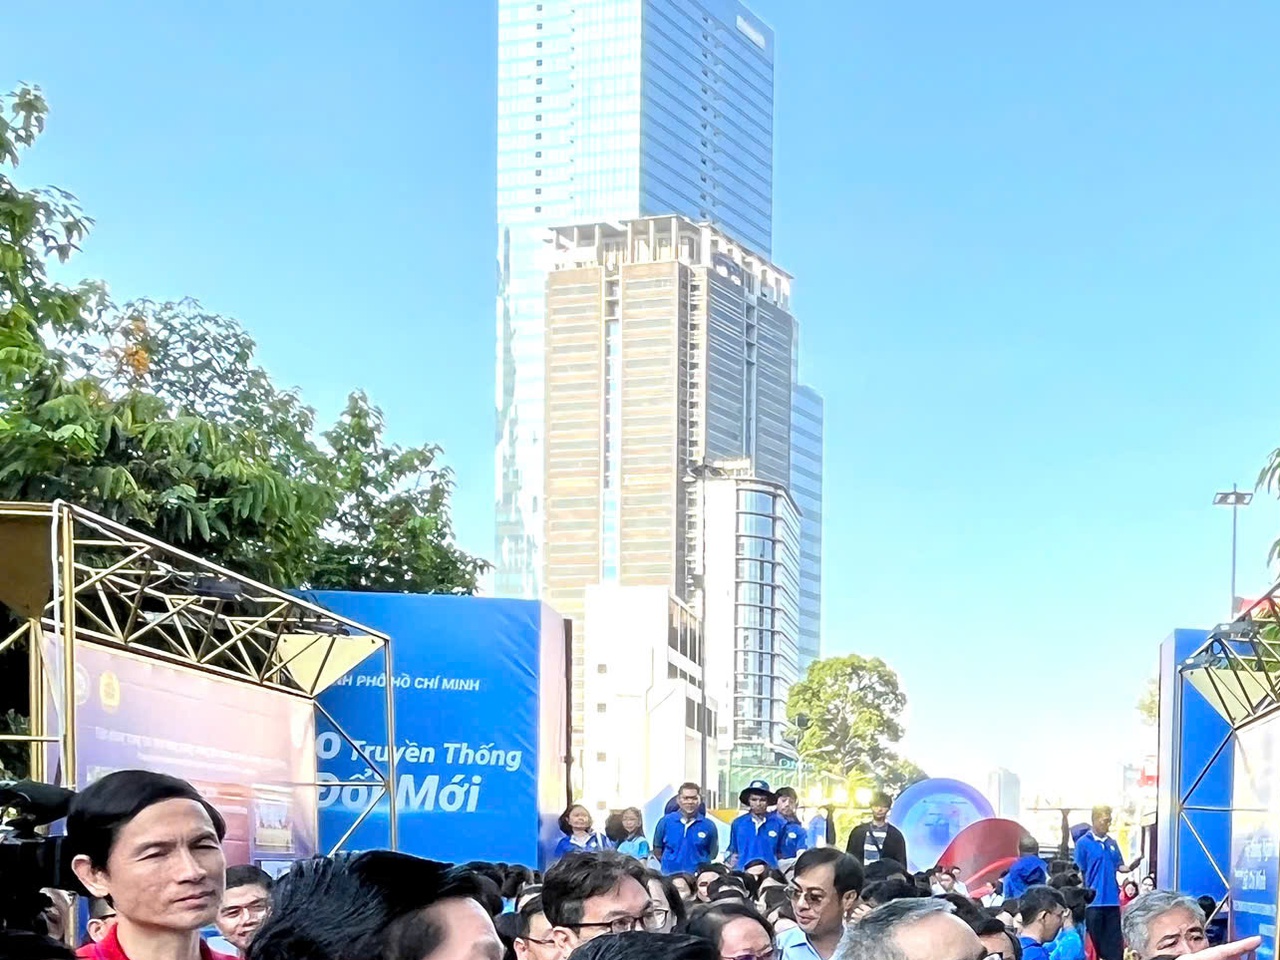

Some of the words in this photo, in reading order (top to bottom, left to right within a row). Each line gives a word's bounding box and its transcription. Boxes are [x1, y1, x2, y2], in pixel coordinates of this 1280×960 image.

[414, 674, 440, 690] CHÍ
[441, 678, 480, 691] MINH
[351, 739, 435, 766] Truyền
[443, 742, 522, 771] Thống
[396, 773, 482, 812] Mới
